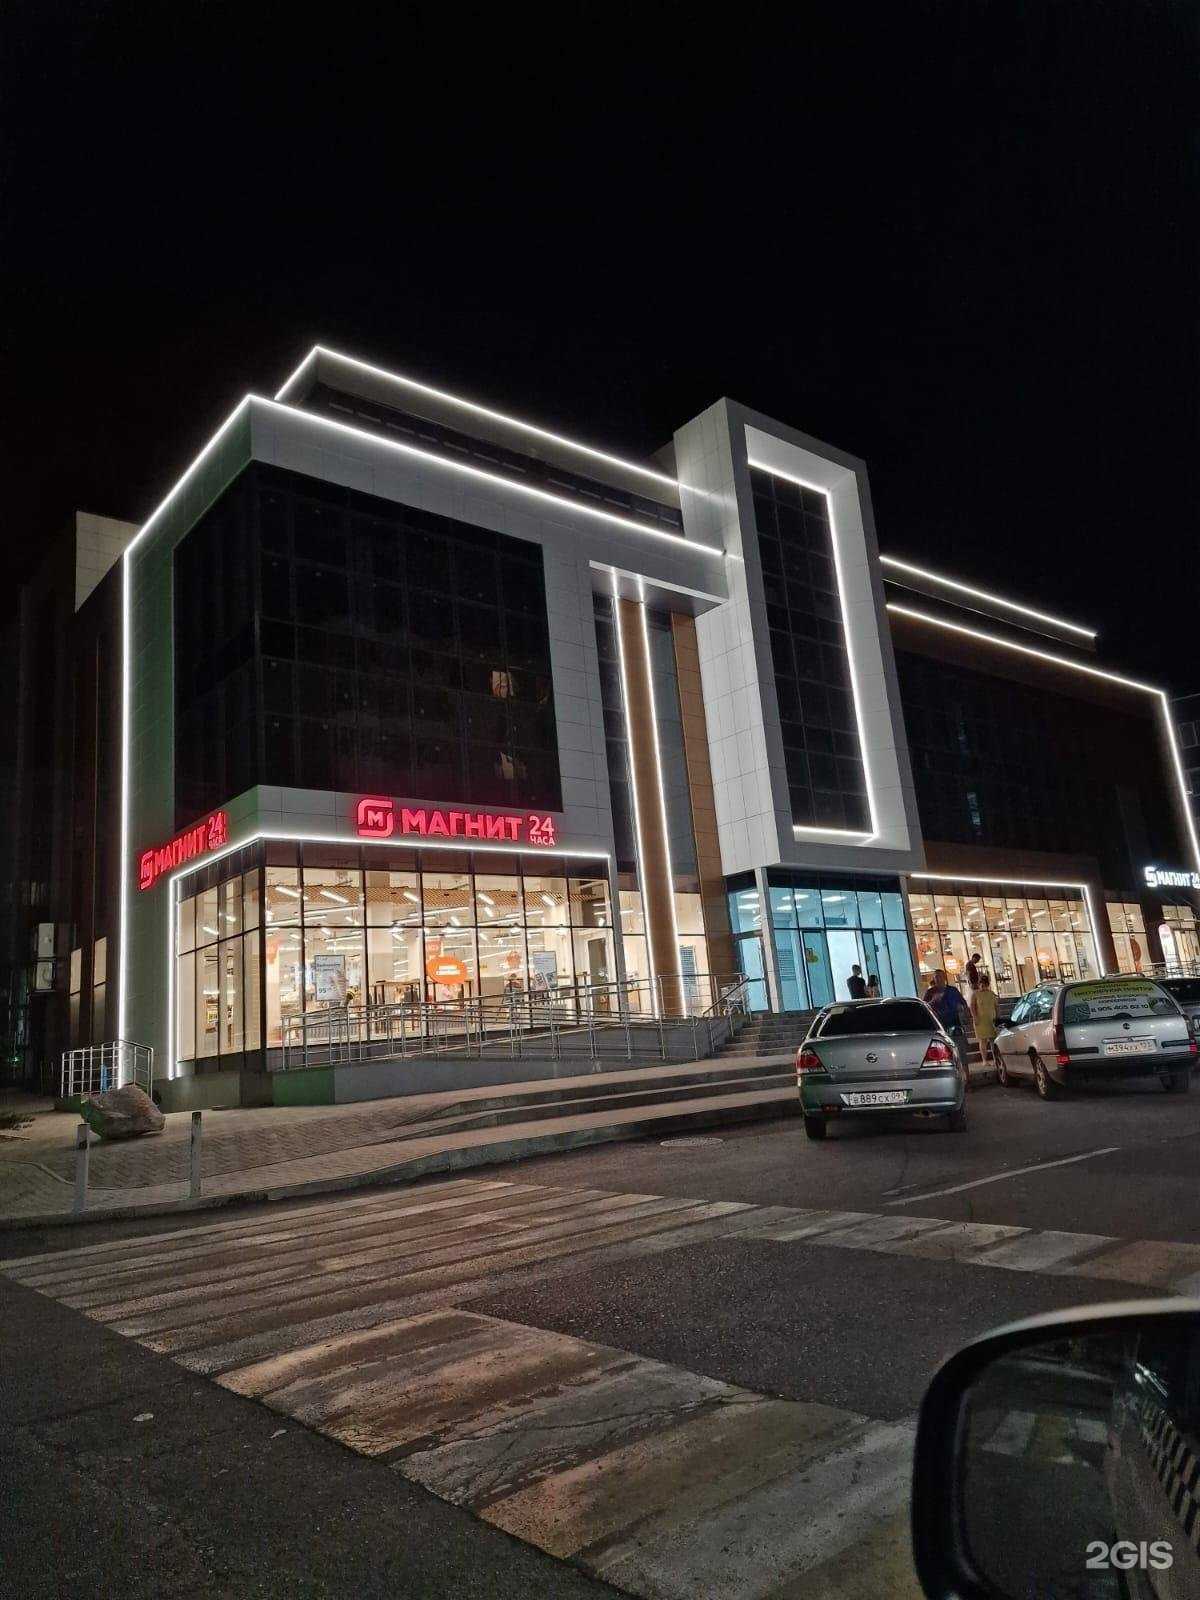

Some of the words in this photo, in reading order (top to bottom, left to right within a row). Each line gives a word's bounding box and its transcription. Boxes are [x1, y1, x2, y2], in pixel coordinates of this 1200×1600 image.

[401, 808, 523, 841] МАГНИТ
[529, 815, 555, 835] 24
[154, 824, 206, 876] МАГНИТ
[530, 835, 555, 846] ЧАСА
[1156, 870, 1190, 887] МАГНИТ
